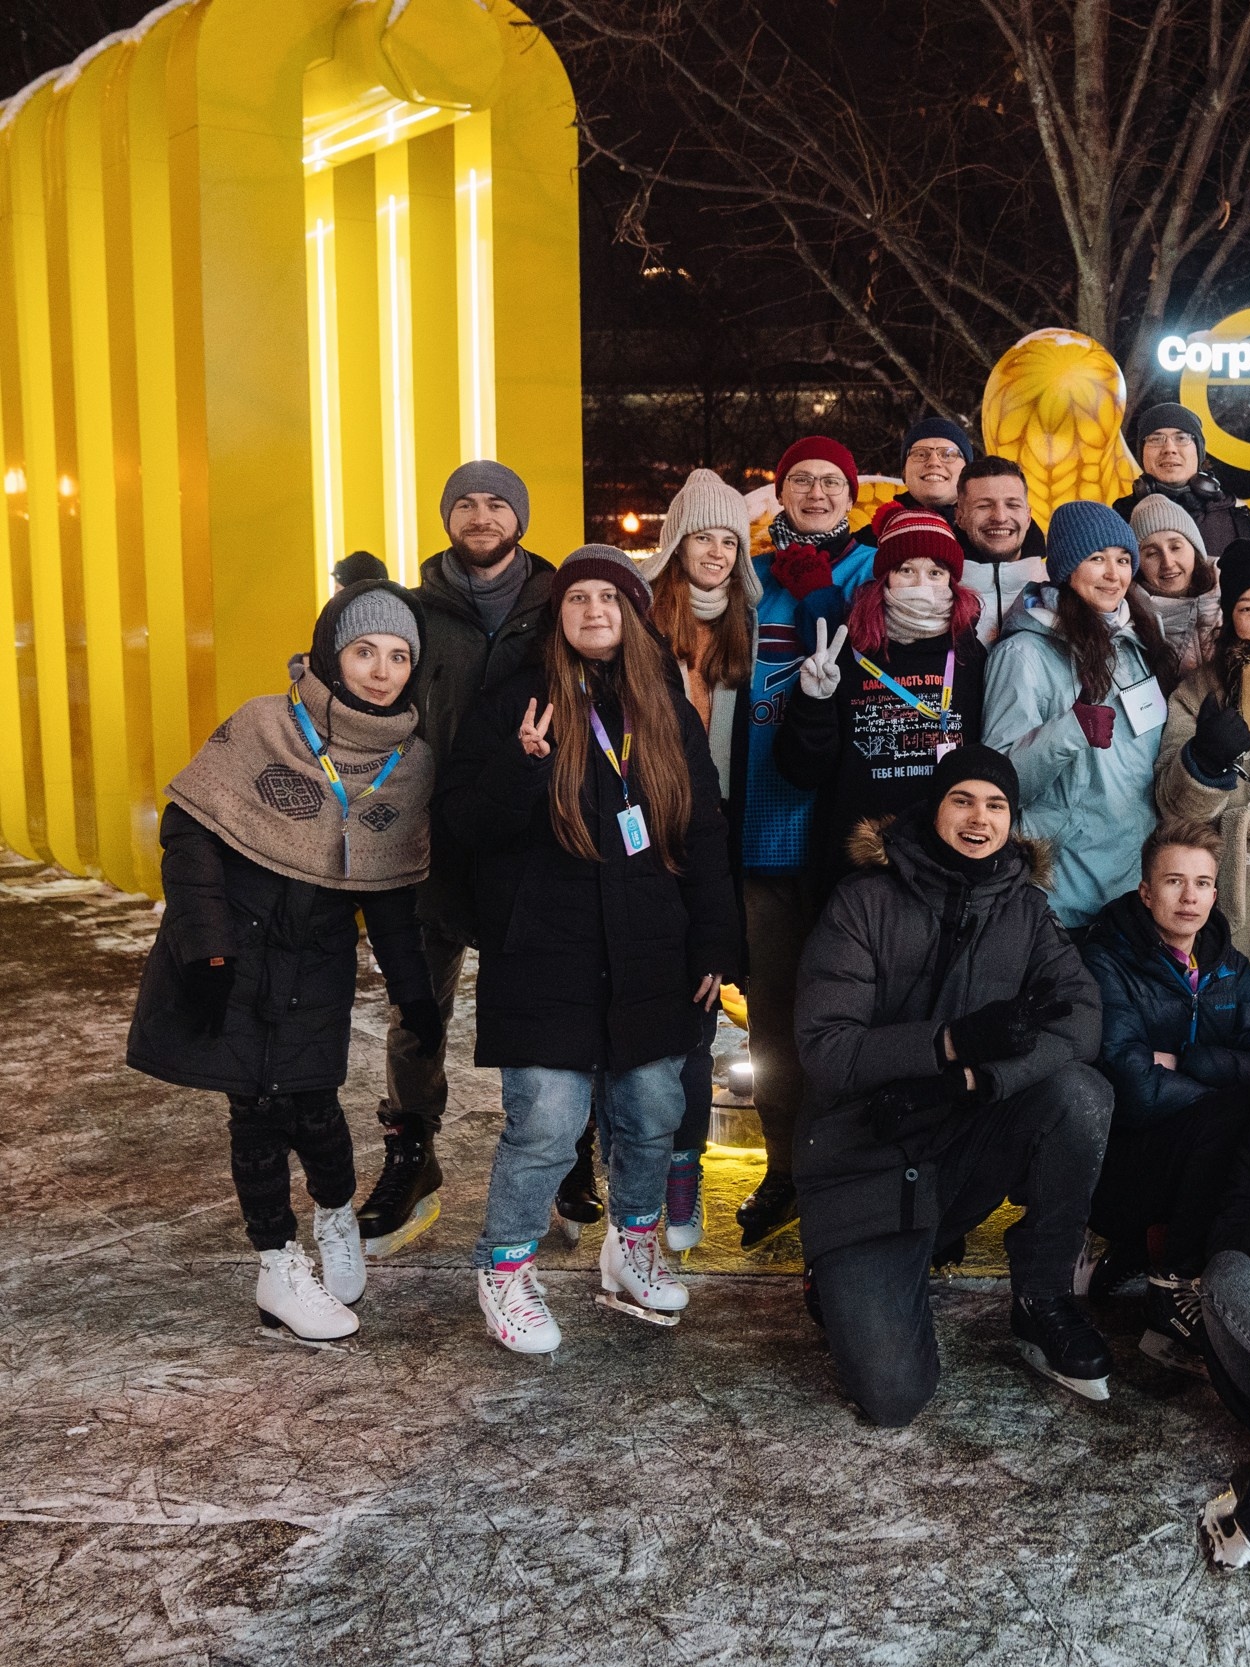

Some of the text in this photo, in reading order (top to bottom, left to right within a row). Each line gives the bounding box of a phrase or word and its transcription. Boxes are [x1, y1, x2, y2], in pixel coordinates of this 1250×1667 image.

[863, 678, 888, 691] КАКА
[924, 674, 945, 686] ЭТОГ
[872, 767, 892, 779] ТЕБЕ
[894, 765, 906, 778] НЕ
[671, 1152, 689, 1162] GX
[636, 1211, 659, 1225] RGX
[505, 1245, 531, 1260] RGX
